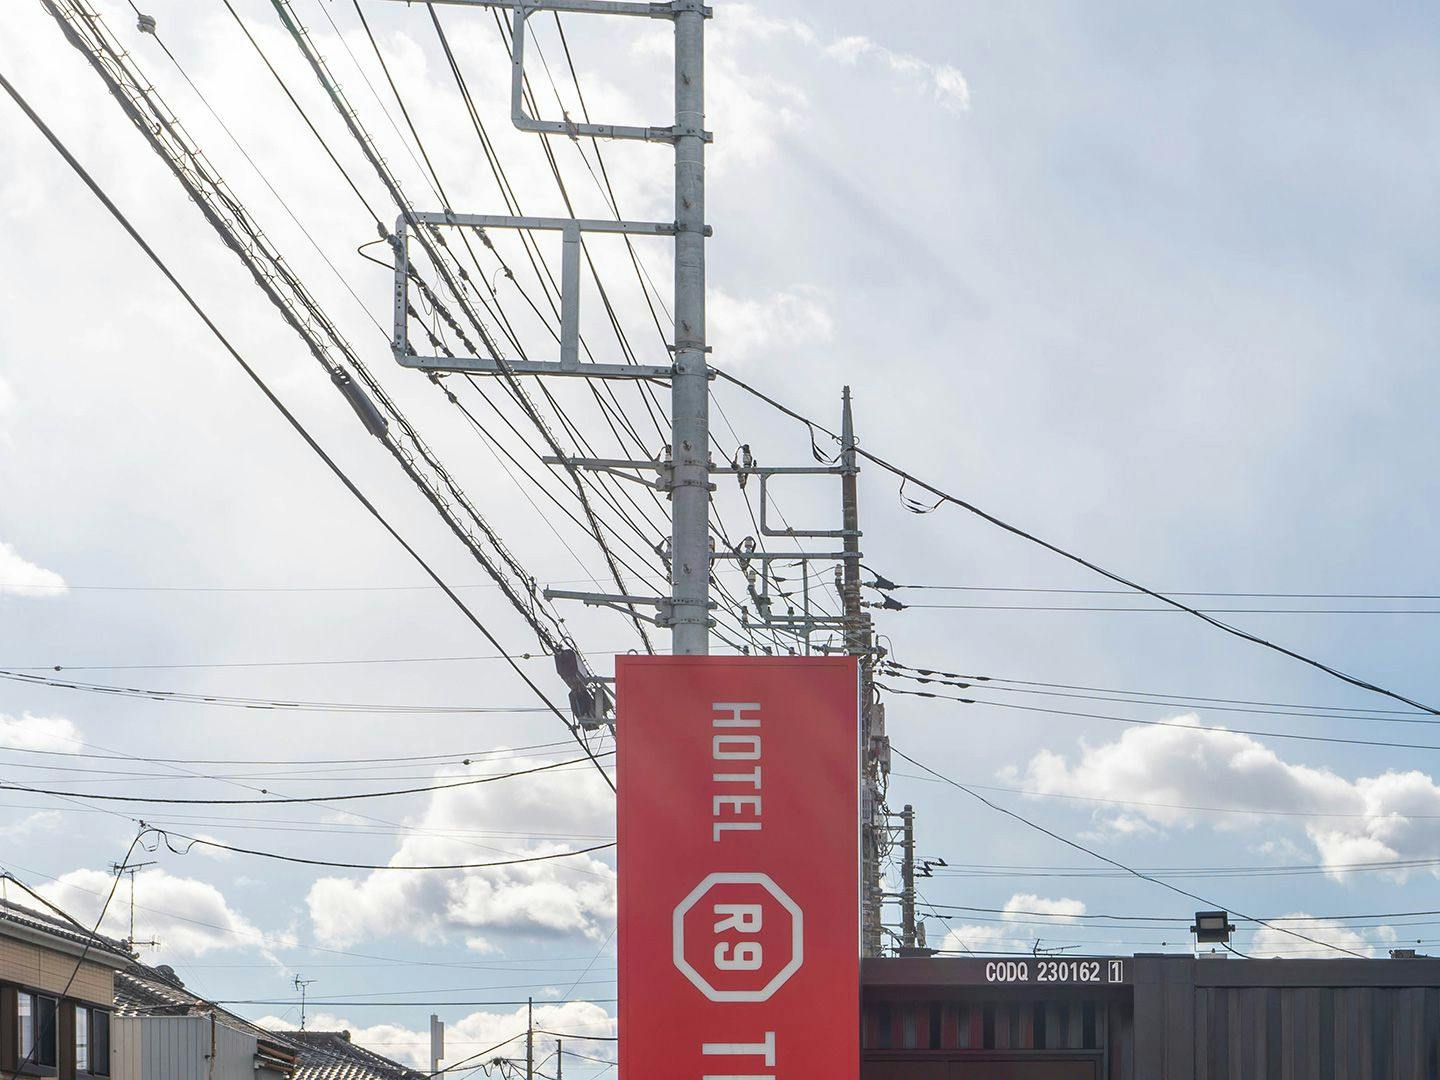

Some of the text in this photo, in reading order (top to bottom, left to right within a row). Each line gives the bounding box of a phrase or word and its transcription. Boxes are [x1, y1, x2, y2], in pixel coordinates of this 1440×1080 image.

[713, 703, 762, 842] HOTEL
[713, 904, 763, 970] R9
[986, 961, 1121, 982] CODQ 230162 1
